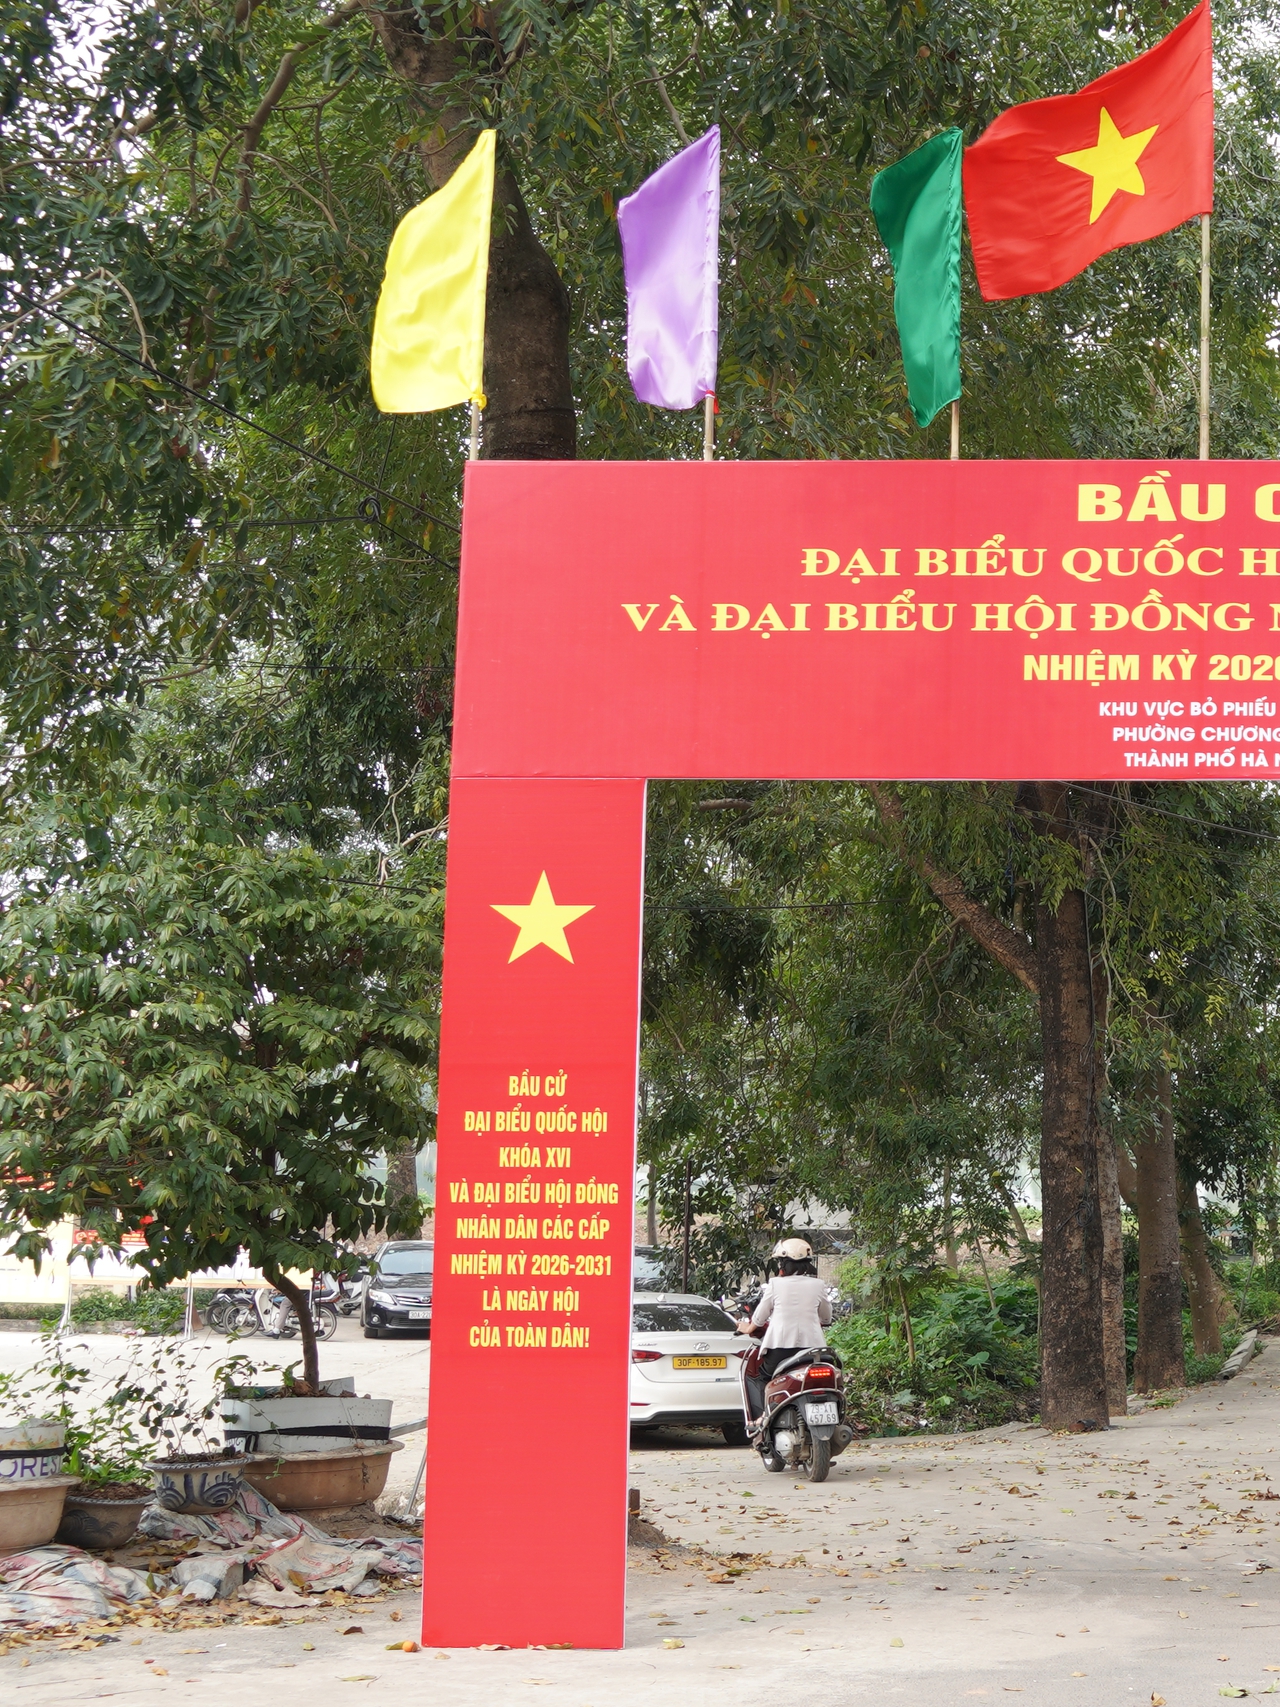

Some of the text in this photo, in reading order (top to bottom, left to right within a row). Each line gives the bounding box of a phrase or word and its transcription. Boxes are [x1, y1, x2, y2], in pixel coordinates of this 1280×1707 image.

[1078, 471, 1226, 521] BẦU
[801, 548, 901, 584] ĐẠI
[914, 534, 1047, 576] BIỂU
[1062, 534, 1223, 582] QUỐC
[621, 595, 697, 631] VÀ
[711, 603, 811, 639] ĐẠI
[824, 589, 957, 631] BIỂU
[971, 595, 1077, 639] HỘI
[1090, 589, 1255, 631] ĐỒNG
[1024, 649, 1139, 686] NHIỆM
[1153, 649, 1197, 680] KỲ
[1099, 702, 1137, 716] KHU
[1144, 700, 1184, 720] VỰC
[1190, 697, 1217, 716] BỎ
[1223, 696, 1276, 716] PHIẾU
[1113, 723, 1195, 741] PHƯỜNG
[1124, 749, 1188, 767] THÀNH
[1195, 747, 1235, 767] PHỐ
[1241, 749, 1269, 767] HÀ
[509, 1069, 567, 1096] BẦU CỬ
[464, 1103, 607, 1137] ĐẠI BIỂU QUỐC HỘI
[499, 1143, 570, 1167] KHÓA XVI
[450, 1175, 618, 1208] VÀ ĐẠI BIỂU HỘI ĐỒNG
[457, 1212, 609, 1239] NHÂN DÂN CÁC CẤP
[451, 1250, 611, 1279] NHIỆM KỲ 2026-2031
[483, 1286, 579, 1316] LÀ NGÀY HỘI
[470, 1319, 589, 1347] CỦA TOÀN DÂN!
[677, 1358, 722, 1367] 30F-185.97
[809, 1413, 837, 1425] 457.69
